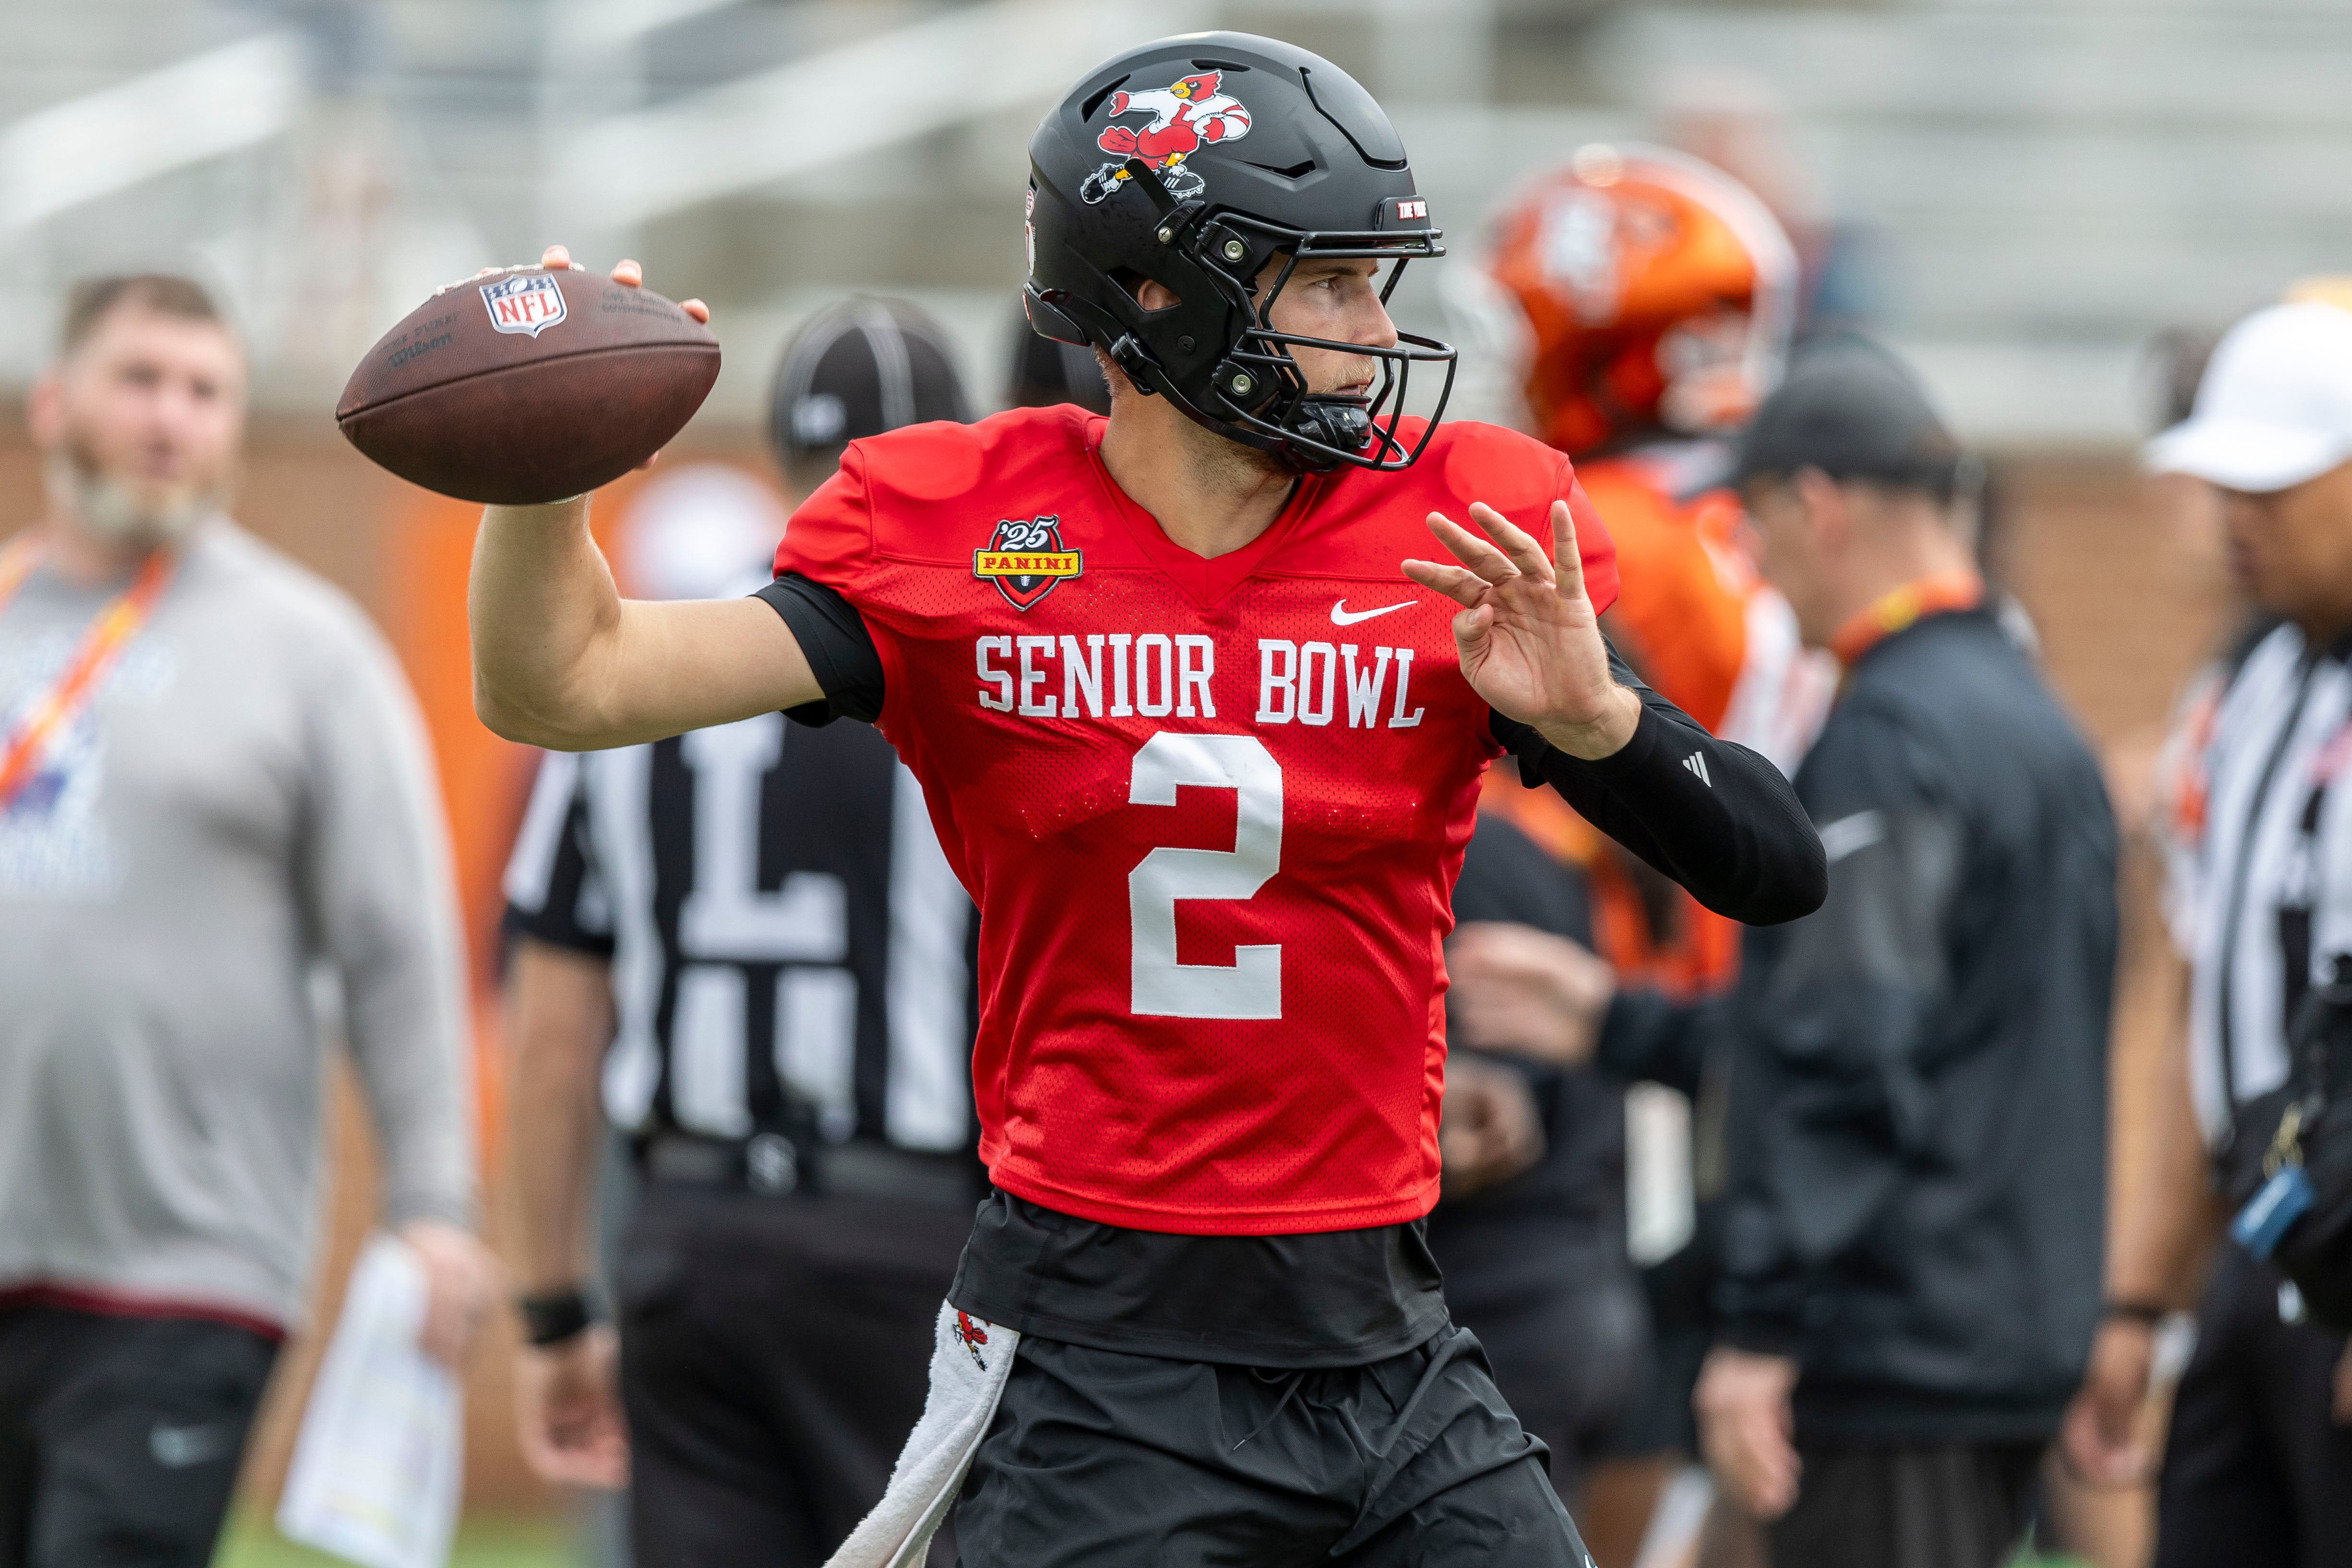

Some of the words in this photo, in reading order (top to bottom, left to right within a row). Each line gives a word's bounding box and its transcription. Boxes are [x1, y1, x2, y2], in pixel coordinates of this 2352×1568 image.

[1397, 202, 1414, 220] THE
[497, 293, 558, 324] NFL
[999, 520, 1055, 551] '25
[983, 557, 1072, 570] PANINI
[976, 632, 1216, 718] SENIOR
[1255, 638, 1425, 729] BOWL
[1128, 730, 1284, 1020] 2
